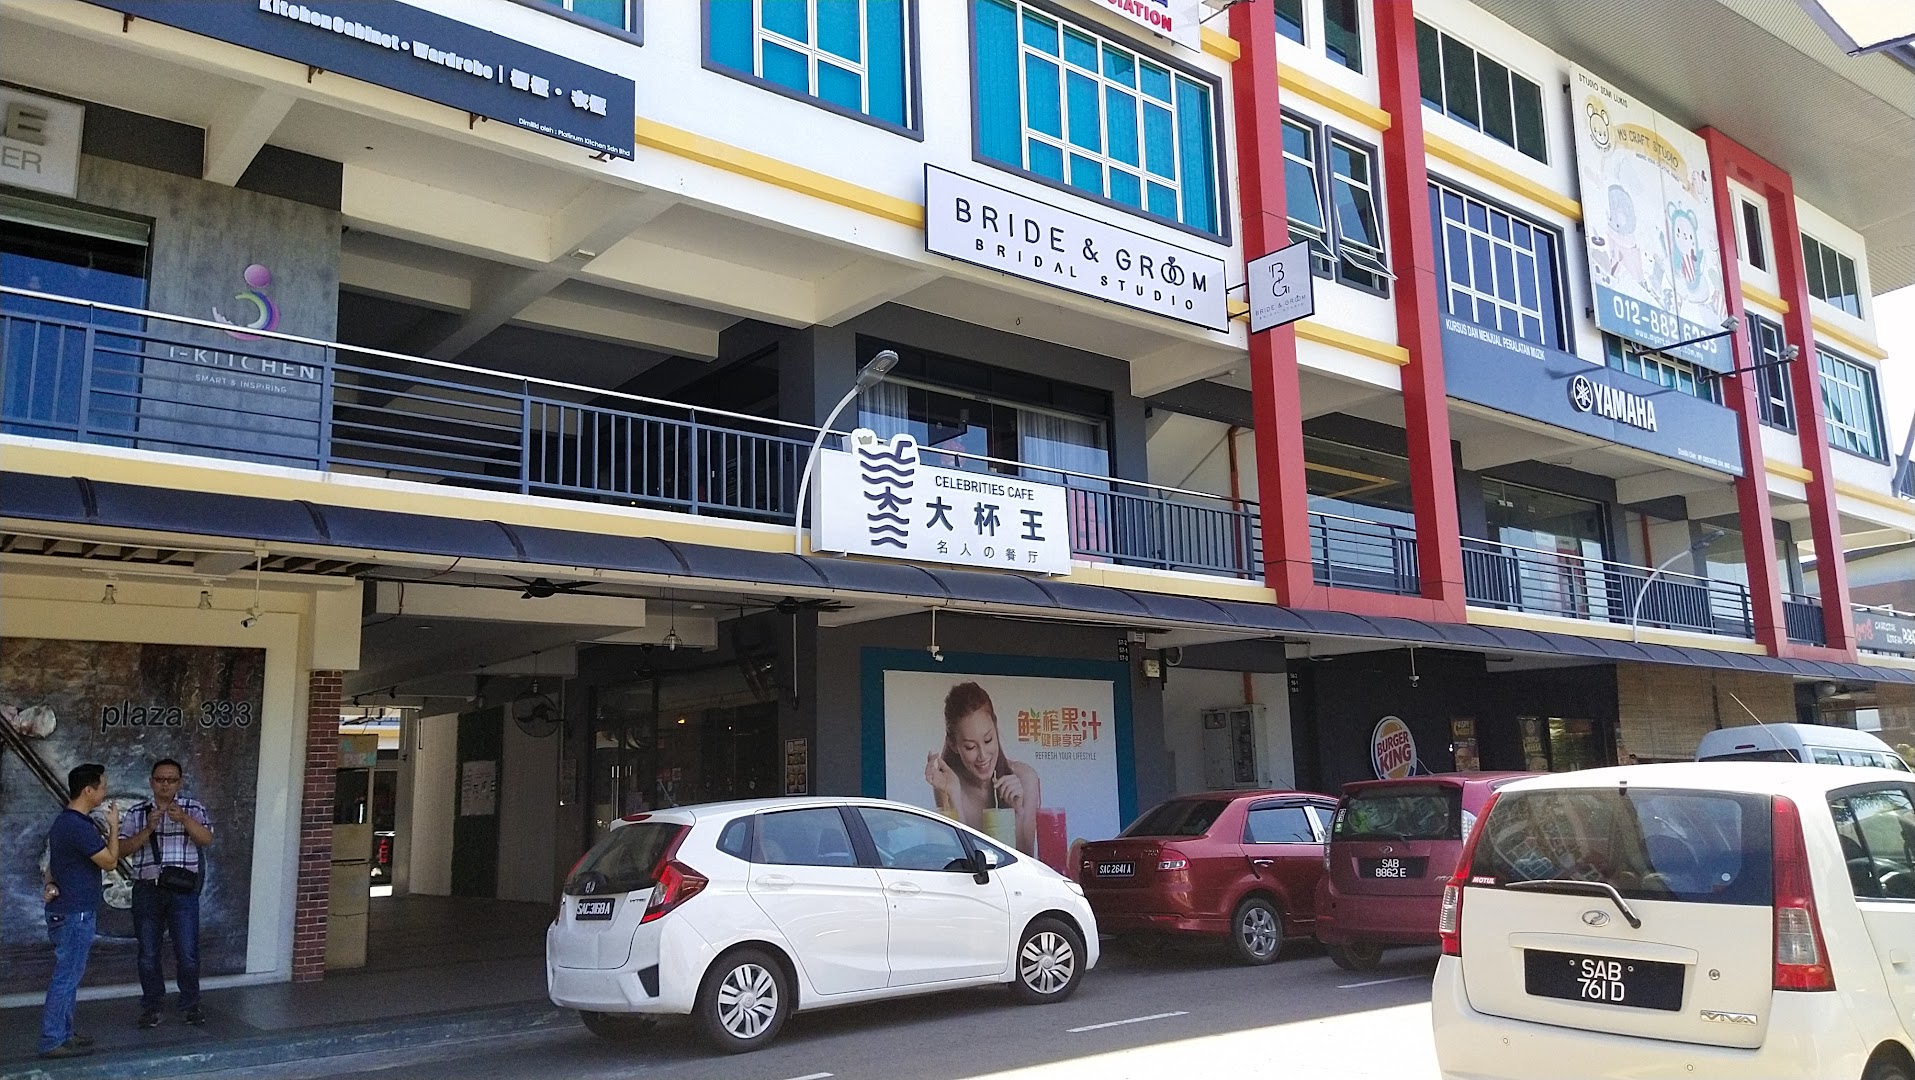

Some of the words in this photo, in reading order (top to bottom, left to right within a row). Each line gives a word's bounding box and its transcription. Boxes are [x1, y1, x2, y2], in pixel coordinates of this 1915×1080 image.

[1108, 0, 1172, 32] IATION
[412, 40, 493, 79] Wardrobe
[1578, 73, 1599, 91] STUDIO
[558, 129, 584, 144] Platinum
[584, 137, 607, 151] Kitchen
[607, 144, 618, 154] Sdn
[619, 147, 631, 157] Bhd
[1616, 128, 1628, 141] MY
[1629, 129, 1650, 149] CRAFT
[1652, 140, 1679, 168] STUDIO
[955, 197, 1066, 254] BRIDE
[1082, 237, 1100, 264] &
[1116, 247, 1207, 293] GROOM
[975, 238, 1078, 280] BRIDAL
[1100, 275, 1194, 311] STUDIO
[1255, 304, 1275, 317] BRIDE
[1445, 318, 1468, 335] KURSUS
[1467, 325, 1479, 339] DAN
[1479, 328, 1503, 347] MENJUAL
[1502, 337, 1531, 356] PERALATAN
[1529, 346, 1546, 361] MUZIK
[195, 373, 227, 385] SMART
[240, 380, 288, 394] INSPIRING
[1593, 381, 1658, 432] YAMAHA
[935, 475, 1005, 497] CELEBRITIES
[1007, 486, 1034, 501] CAFE
[926, 496, 1046, 542] 大杯王
[936, 540, 1039, 563] 名人の餐厅
[101, 699, 183, 734] plaza
[198, 700, 253, 729] 333
[1017, 707, 1102, 742] 鲜榨果汁
[1041, 733, 1083, 748] 健康享受
[1376, 731, 1409, 757] BURGER
[1034, 751, 1058, 760] REFRESH
[1059, 752, 1072, 760] YOUR
[1073, 752, 1097, 760] LIFESTYLE
[1379, 744, 1412, 775] KING
[1099, 864, 1111, 874] SAC
[1111, 863, 1126, 874] 2641
[1127, 863, 1131, 874] A
[1375, 868, 1399, 878] 8862
[1400, 867, 1407, 878] E
[1381, 858, 1400, 868] SAB
[1472, 876, 1495, 884] MOTUL
[1581, 959, 1622, 982] SAB
[1577, 977, 1608, 1000] 761
[1611, 981, 1625, 1002] D
[1701, 1011, 1756, 1025] VIVA
